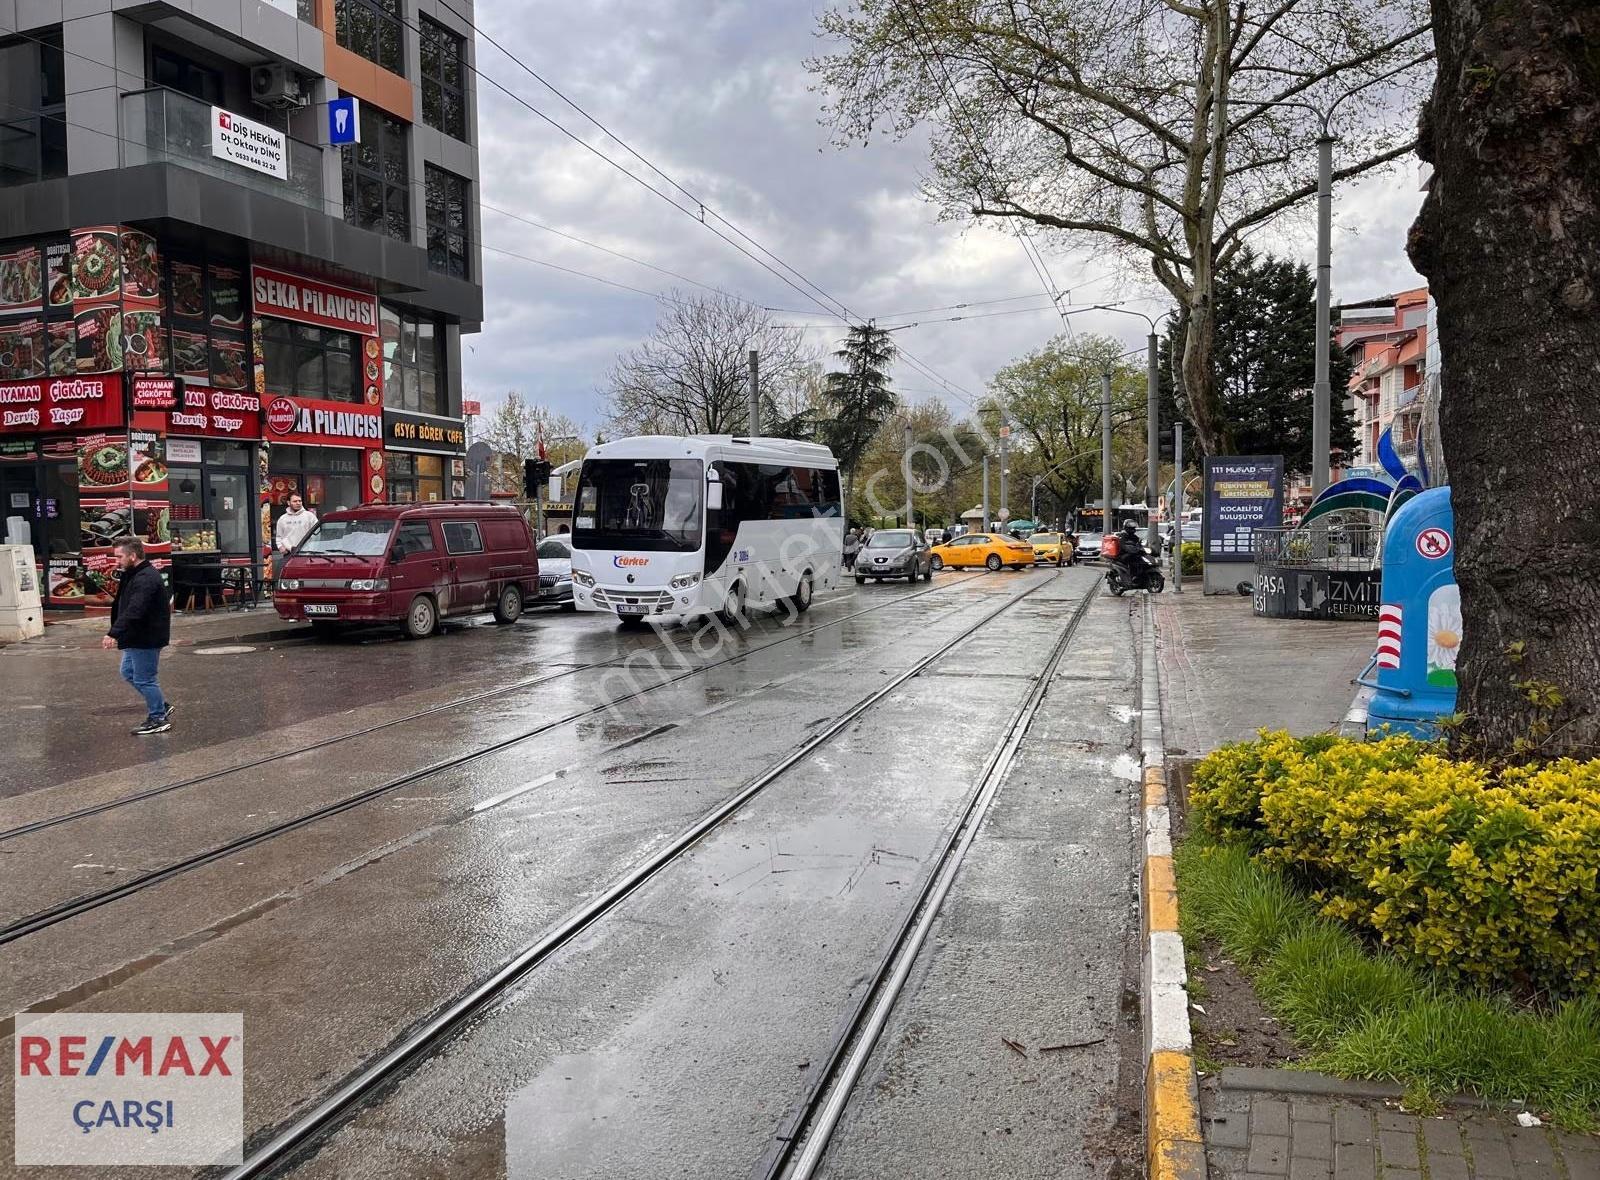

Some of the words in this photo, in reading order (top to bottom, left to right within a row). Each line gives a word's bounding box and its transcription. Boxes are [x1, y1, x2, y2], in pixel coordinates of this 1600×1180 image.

[233, 123, 248, 138] DİŞ
[250, 130, 281, 150] HEKİMİ
[260, 147, 281, 161] DİNÇ
[255, 276, 300, 310] SEKA
[302, 287, 376, 326] PİLAVCISI
[135, 381, 174, 390] ADIYAMAN
[134, 398, 156, 407] Derviş
[157, 398, 176, 407] Yaşar
[271, 401, 289, 411] SEKA
[3, 407, 40, 425] Derviş
[49, 407, 84, 425] Yaşar
[172, 412, 207, 428] Derviş
[213, 415, 243, 432] Yaşar
[314, 409, 383, 439] PİLAVCISI
[394, 422, 416, 440] ASYA
[419, 422, 444, 441] BÖREK
[446, 429, 463, 444] CAFE
[1220, 504, 1263, 512] KOCAELİ'DE
[1219, 513, 1264, 521] BULUŞUYOR
[618, 557, 649, 566] türker
[1327, 576, 1382, 602] İZMİT
